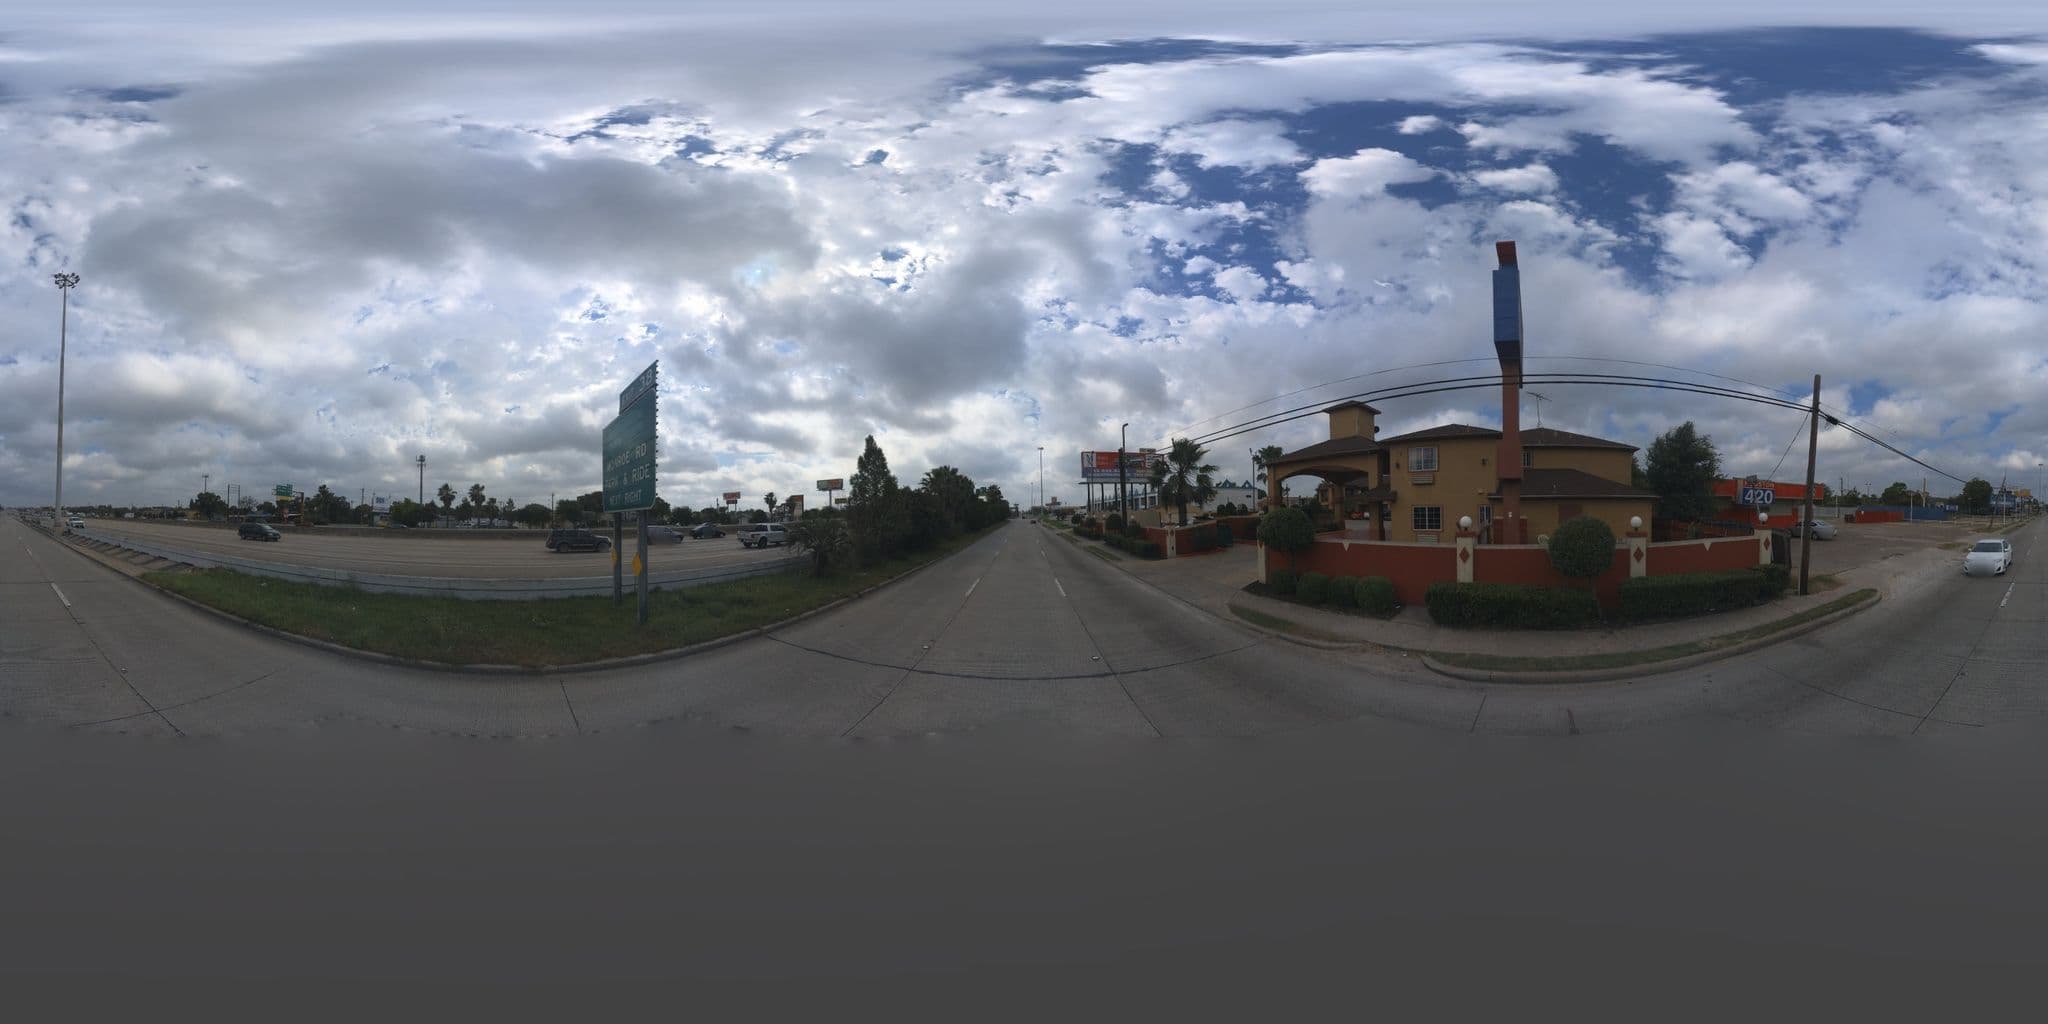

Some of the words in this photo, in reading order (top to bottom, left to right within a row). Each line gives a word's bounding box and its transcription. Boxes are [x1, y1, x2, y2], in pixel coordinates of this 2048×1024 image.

[635, 442, 647, 459] RD
[632, 463, 650, 483] RIDE
[624, 489, 642, 505] RIGHT
[1744, 489, 1773, 504] 420
